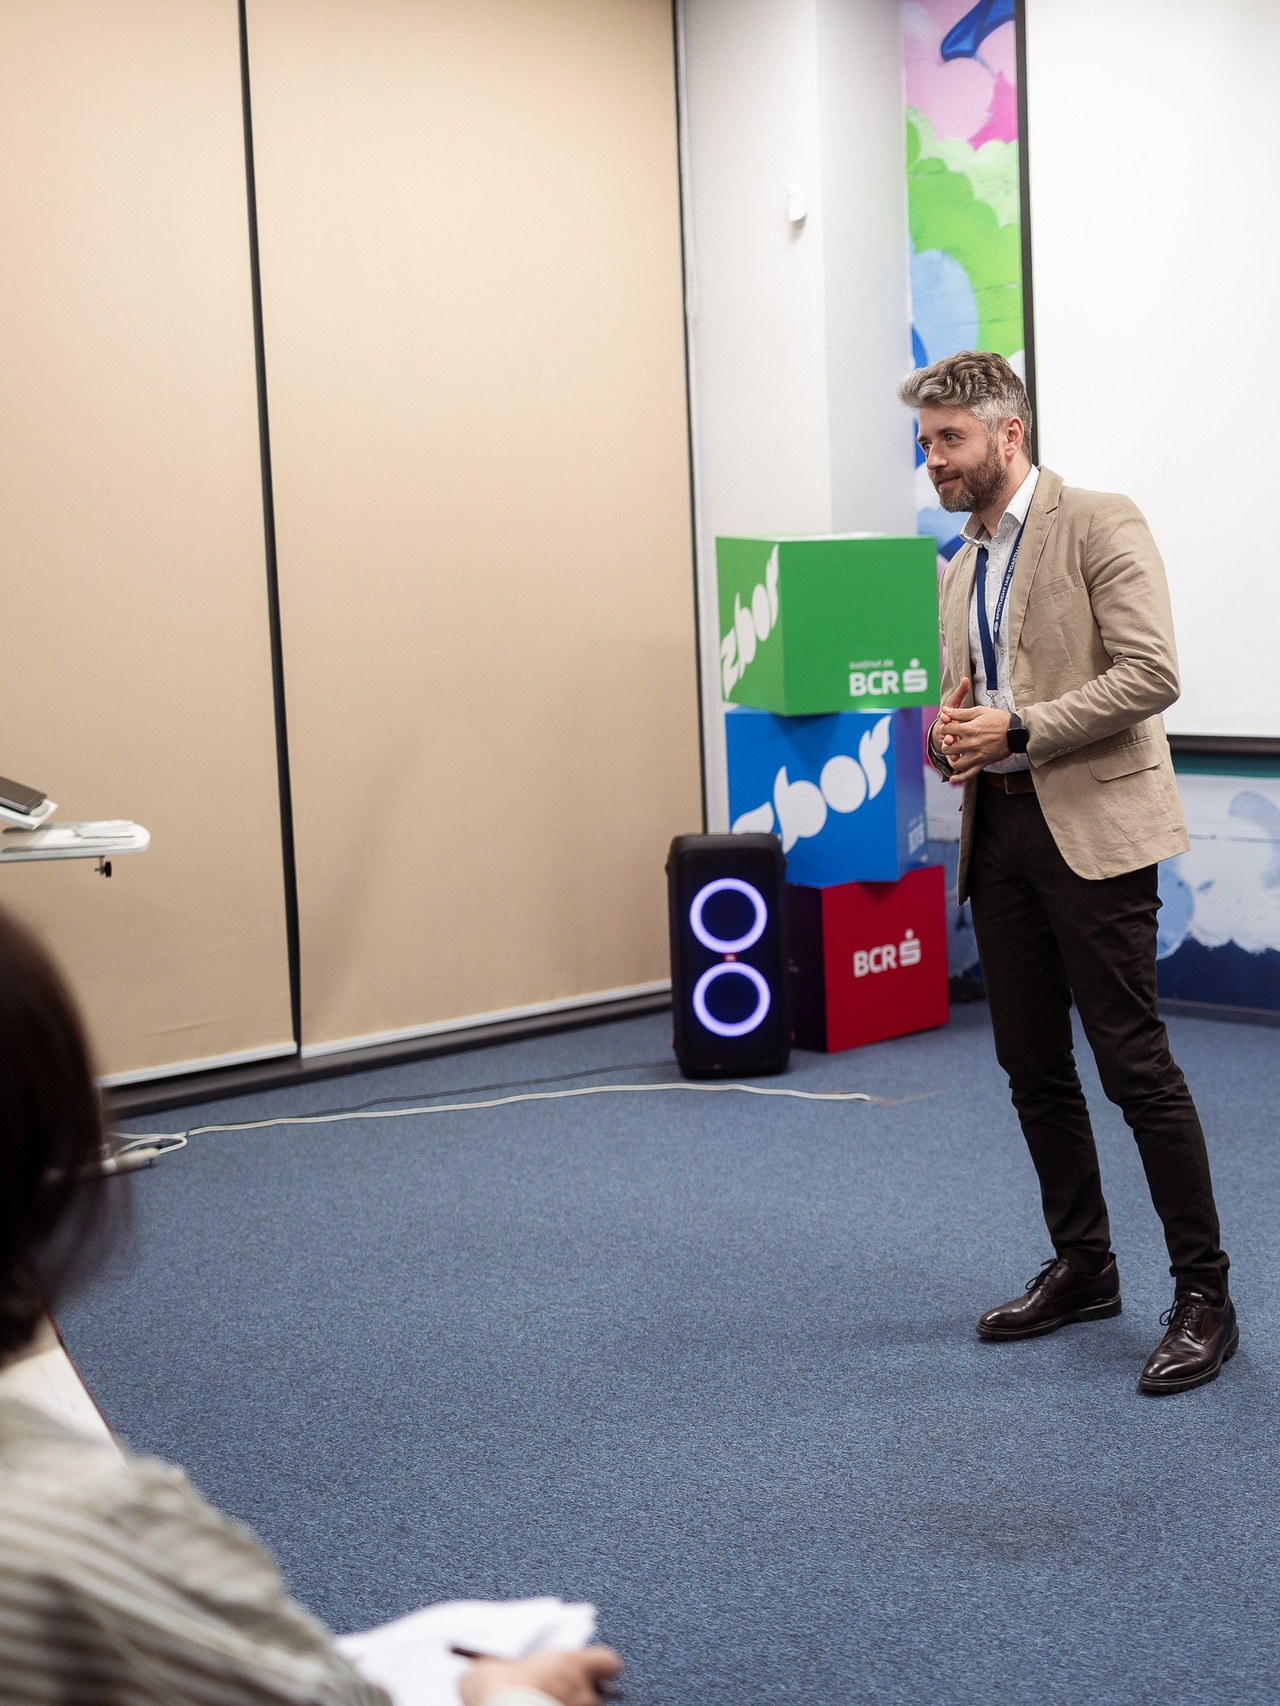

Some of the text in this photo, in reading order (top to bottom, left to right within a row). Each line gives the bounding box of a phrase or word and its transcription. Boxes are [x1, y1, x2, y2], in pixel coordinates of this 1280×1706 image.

[996, 587, 1007, 619] SPOTLIGHT
[849, 670, 900, 697] BCR
[853, 943, 898, 978] BCR
